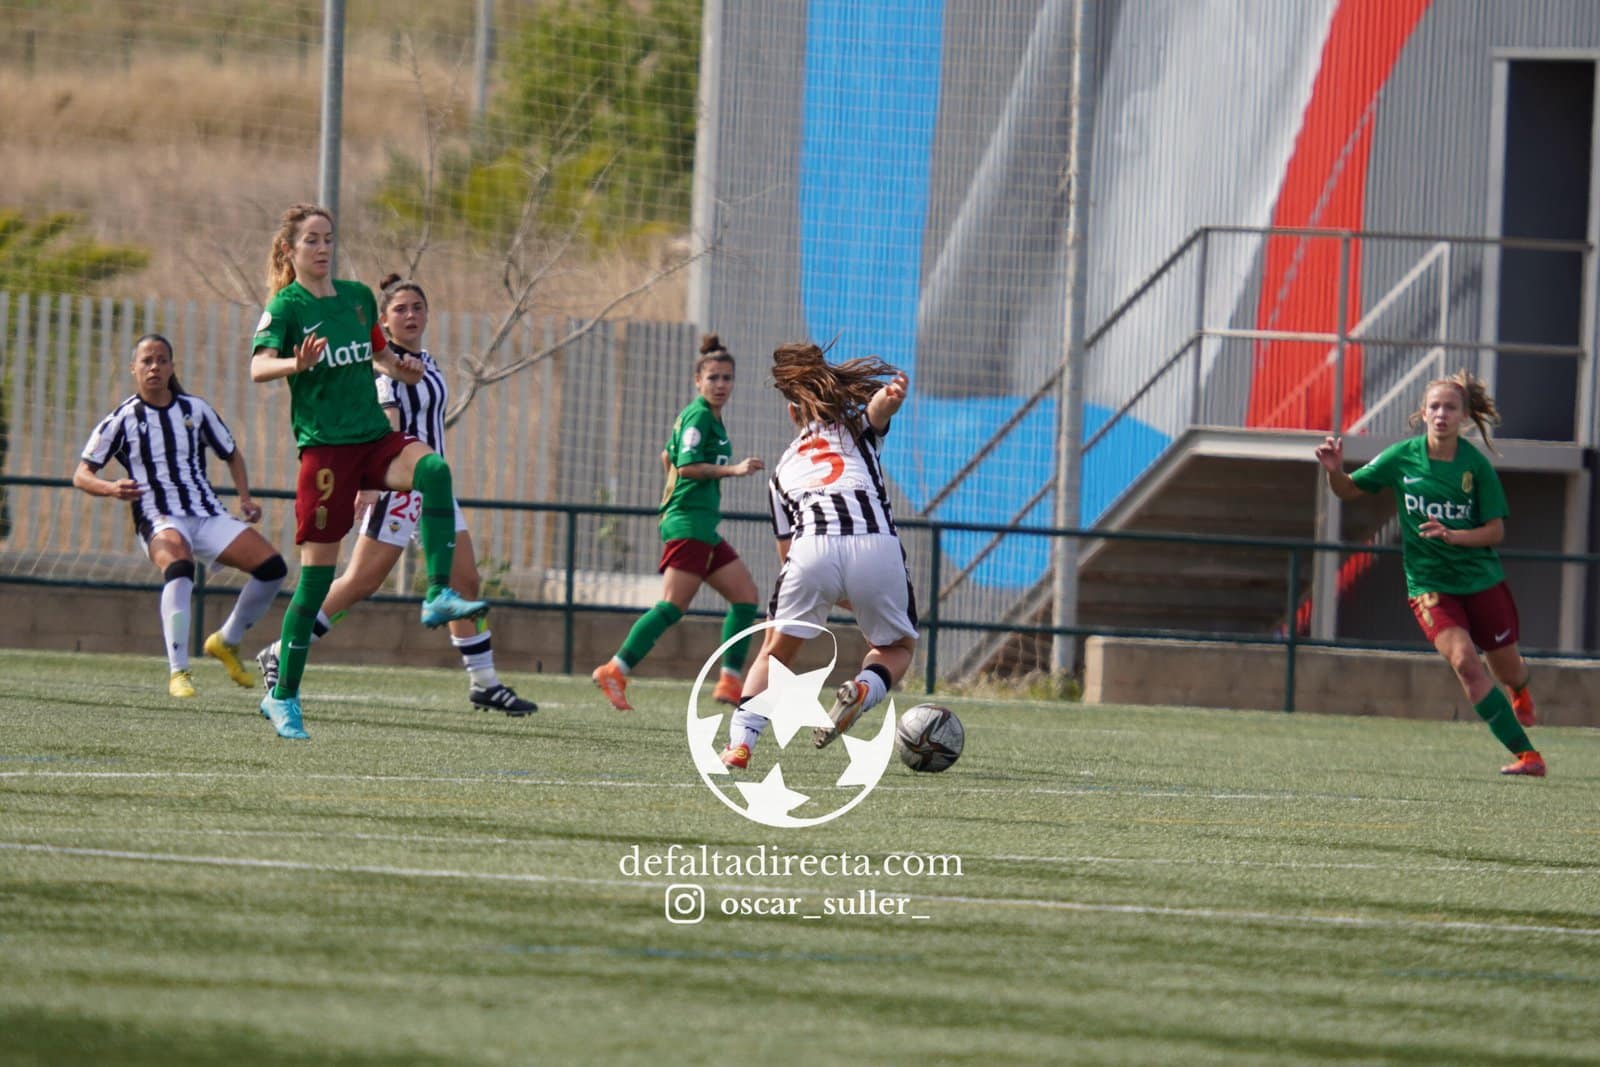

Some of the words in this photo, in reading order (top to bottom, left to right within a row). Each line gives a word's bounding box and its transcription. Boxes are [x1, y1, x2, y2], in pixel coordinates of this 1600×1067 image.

[309, 340, 373, 372] latz
[797, 437, 845, 489] 3
[316, 467, 335, 501] 9
[389, 490, 422, 523] 23
